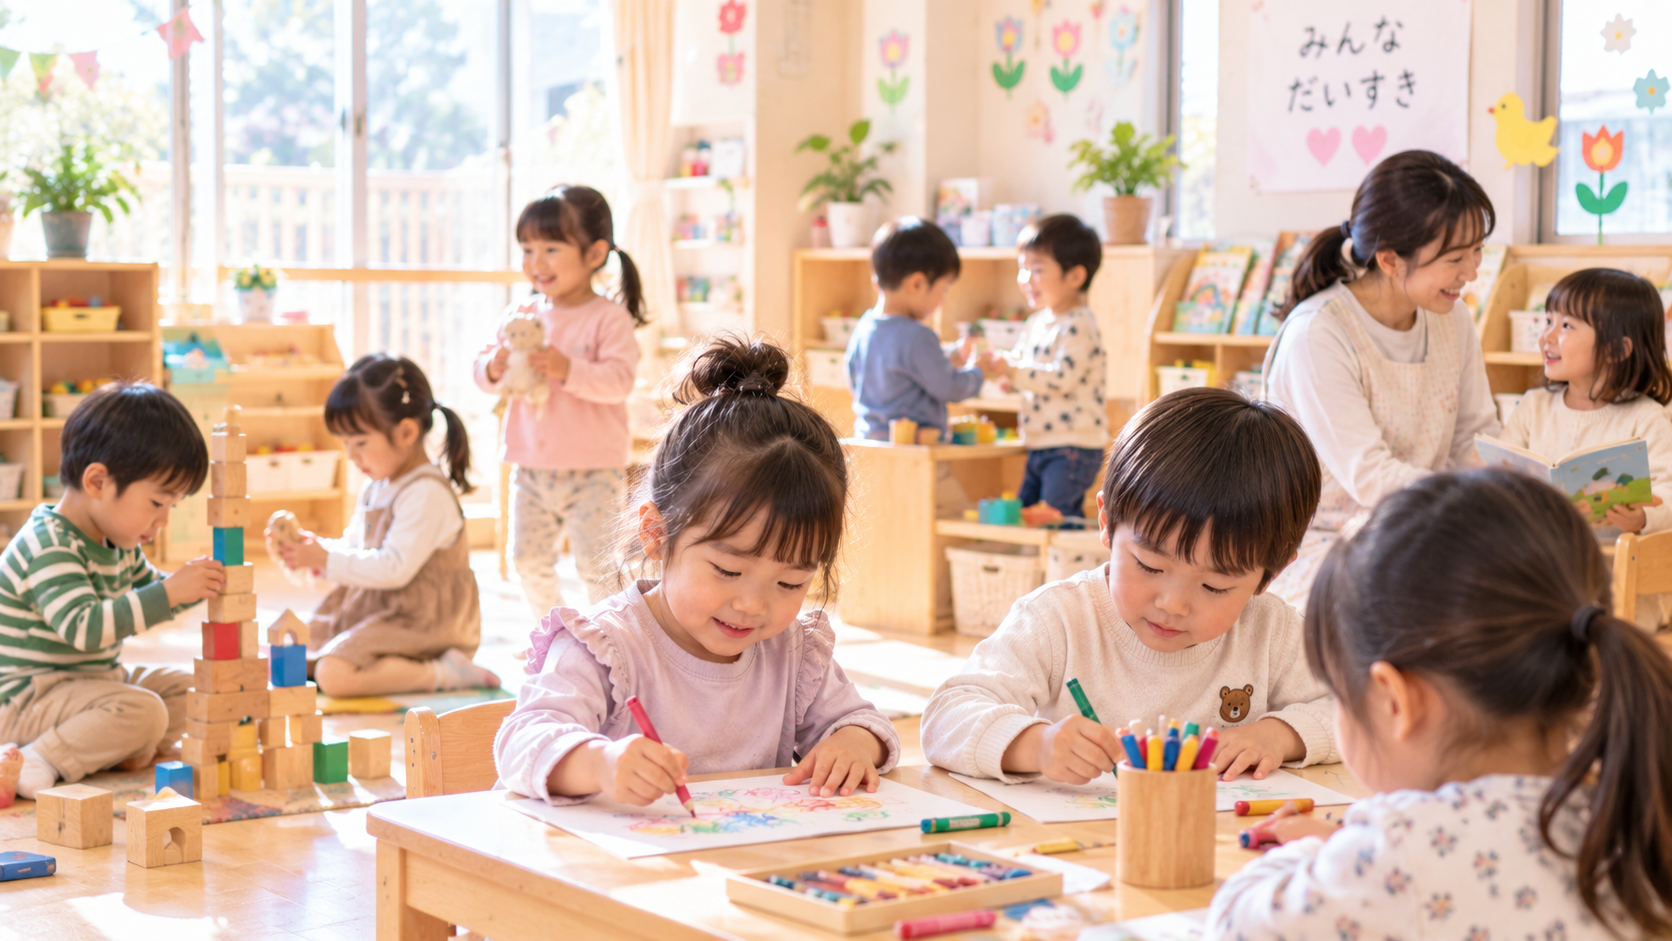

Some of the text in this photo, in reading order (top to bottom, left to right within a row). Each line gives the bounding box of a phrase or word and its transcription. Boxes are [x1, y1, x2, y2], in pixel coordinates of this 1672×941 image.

[1299, 16, 1403, 58] みんな
[1288, 69, 1416, 112] だいすき
